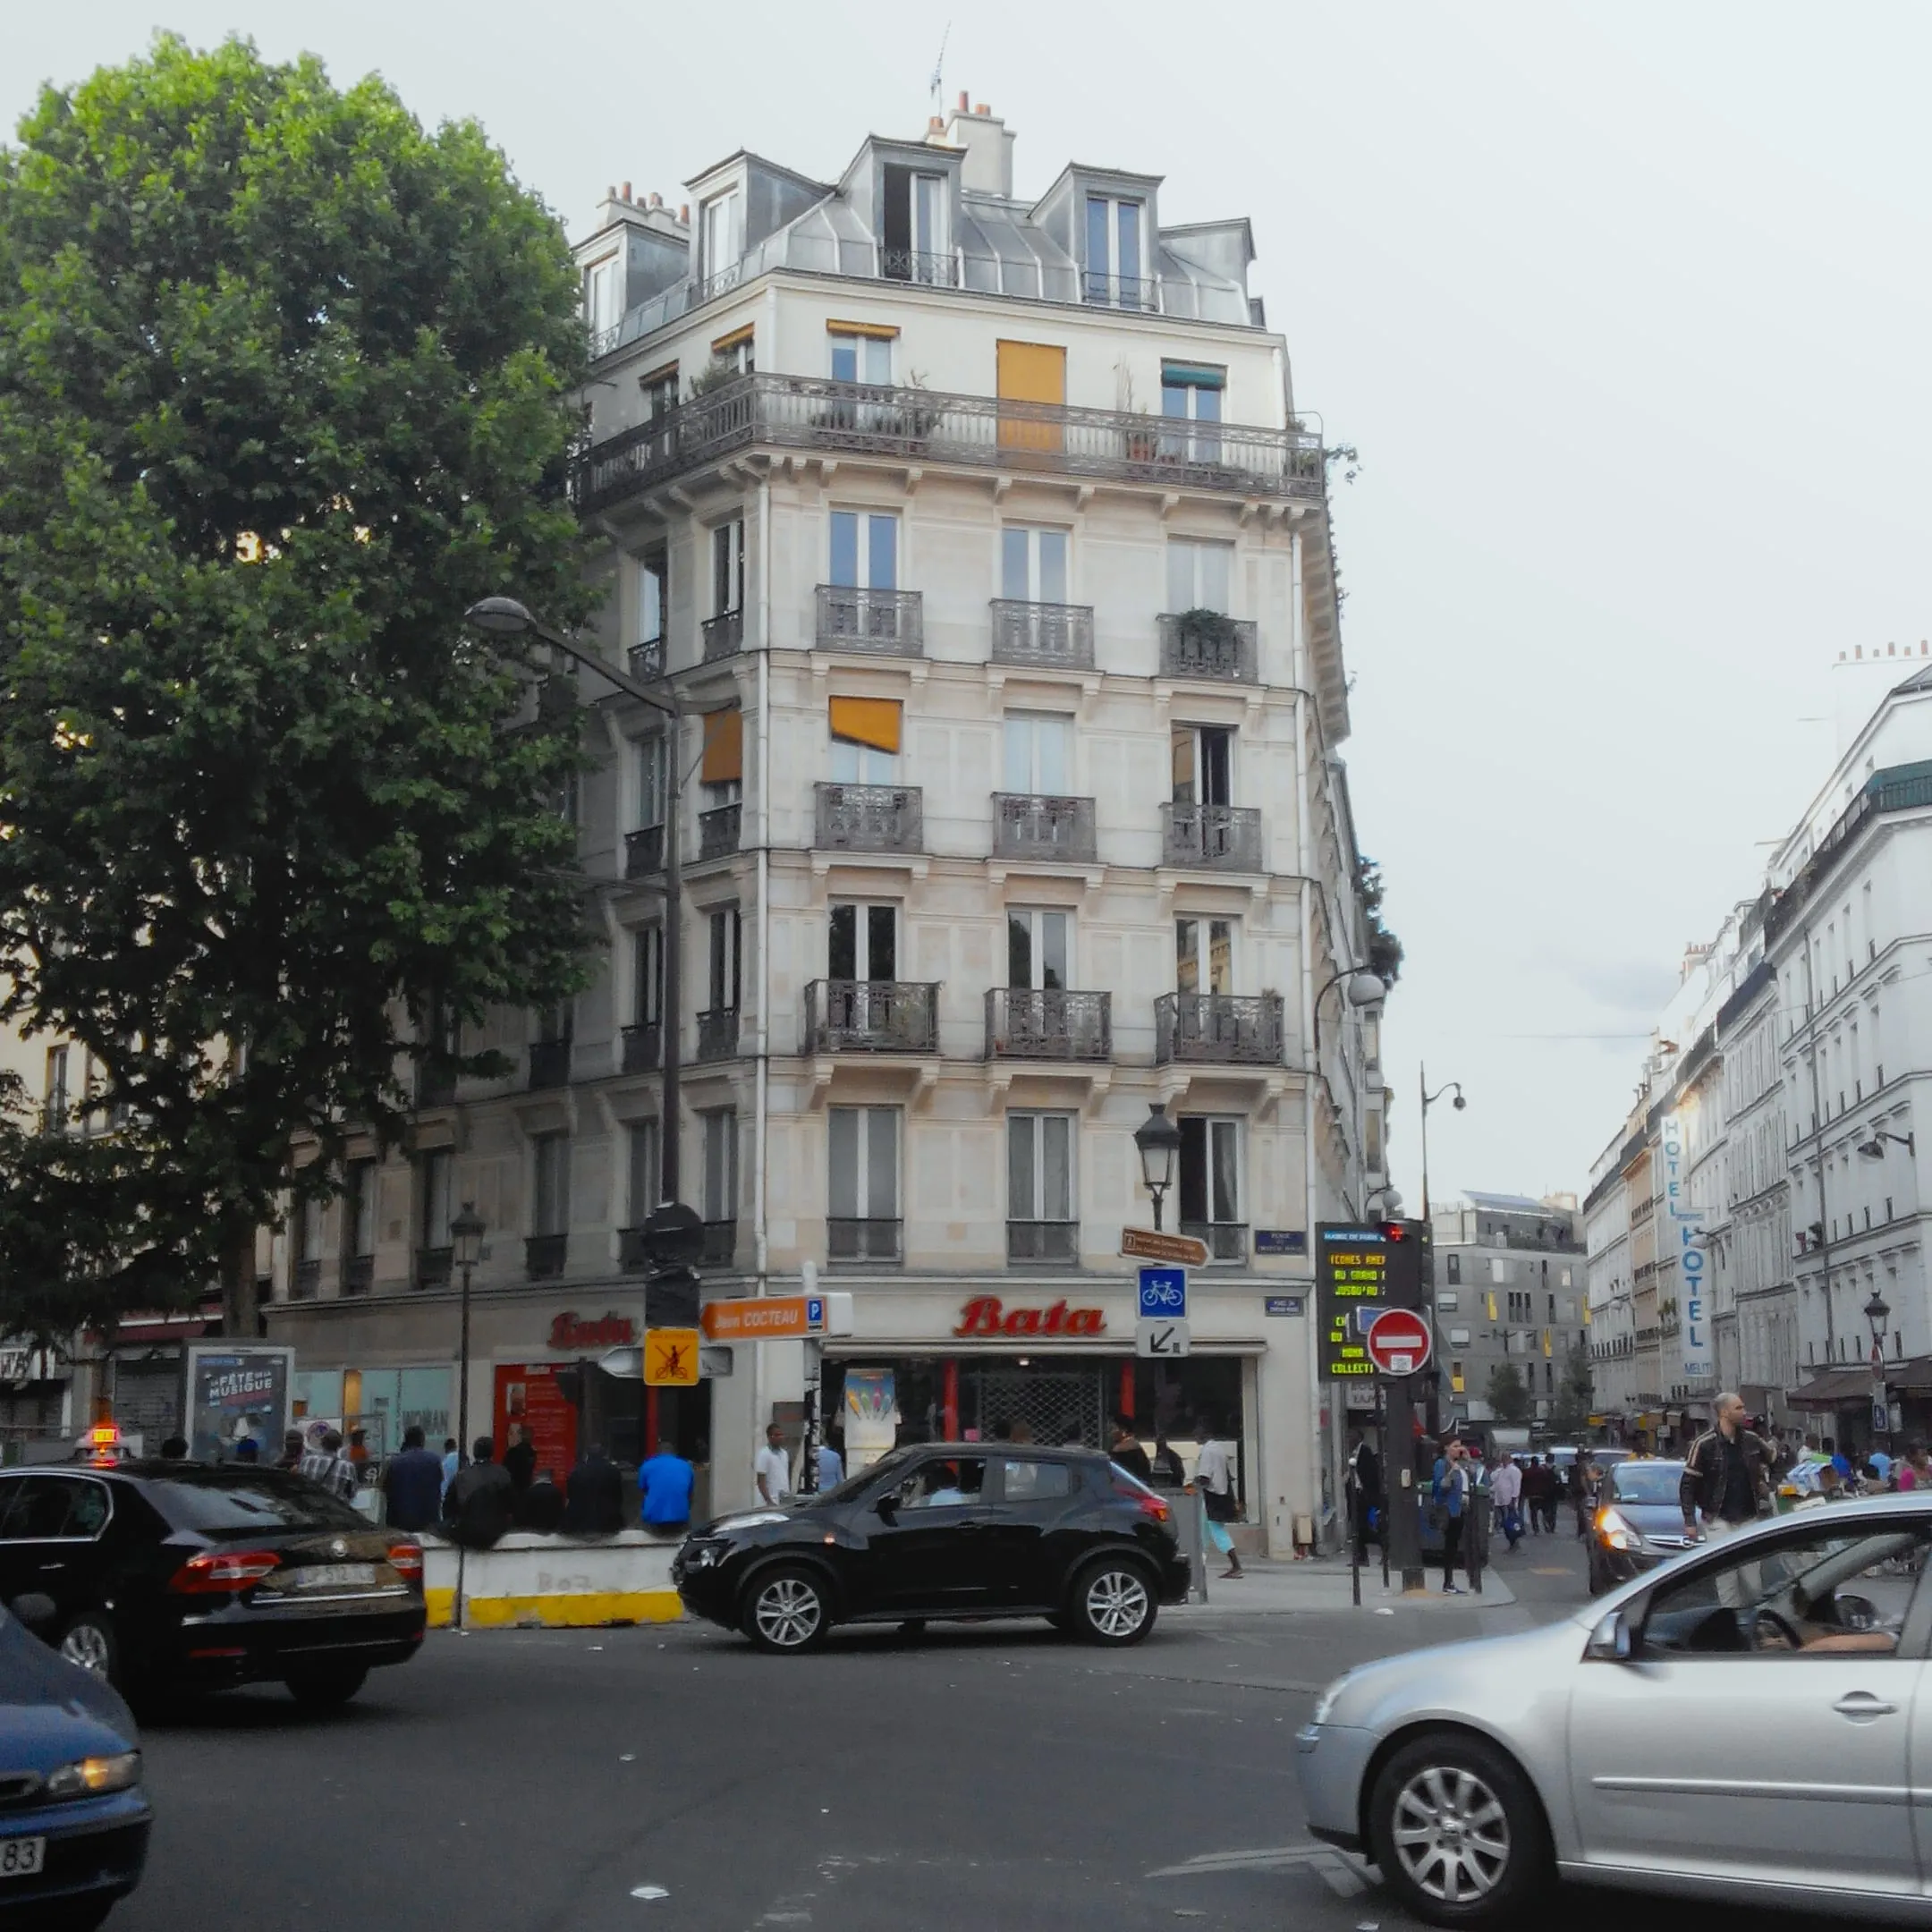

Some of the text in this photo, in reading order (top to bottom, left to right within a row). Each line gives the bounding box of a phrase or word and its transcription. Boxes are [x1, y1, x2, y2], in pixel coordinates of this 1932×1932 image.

[1665, 1121, 1681, 1216] HOTEL
[743, 1309, 798, 1326] COCTEAU
[952, 1294, 1107, 1337] Bata
[209, 1378, 273, 1400] MUSIQUE
[4, 1843, 36, 1870] 83
